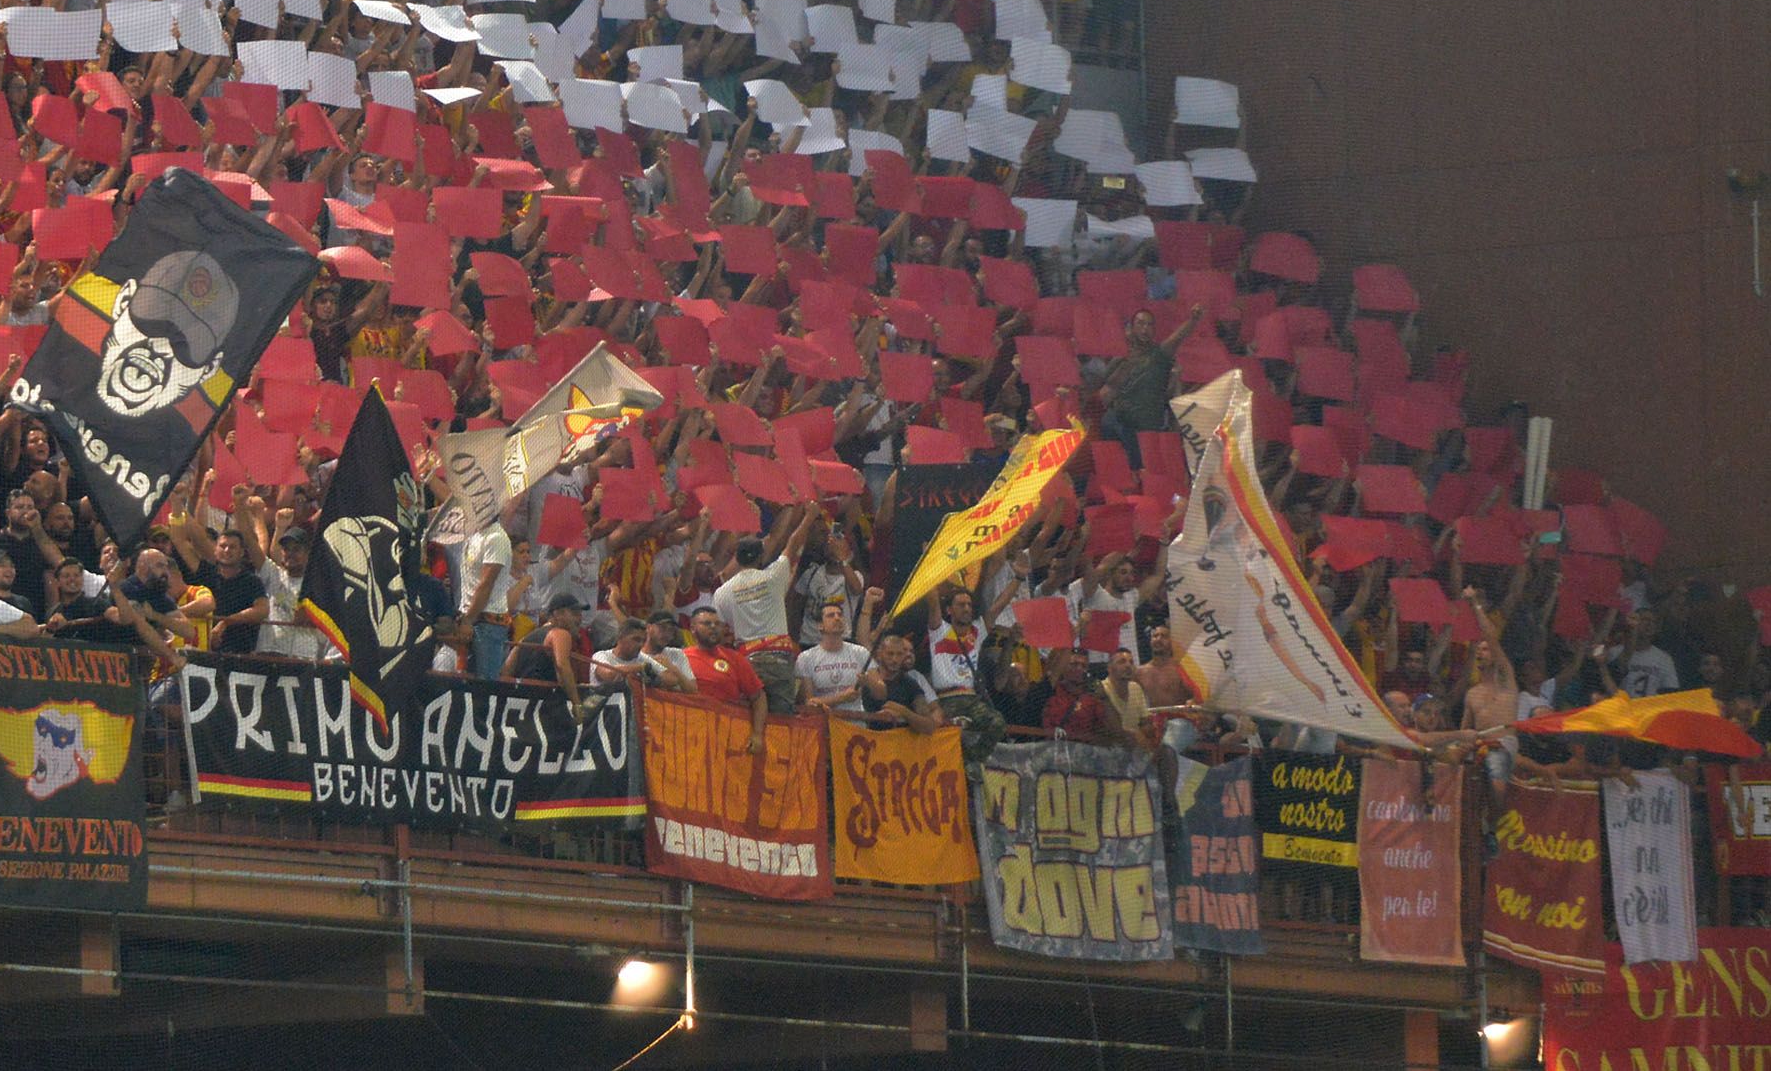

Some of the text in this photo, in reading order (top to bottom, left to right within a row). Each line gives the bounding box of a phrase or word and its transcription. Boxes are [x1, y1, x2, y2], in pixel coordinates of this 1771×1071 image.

[47, 648, 132, 688] MATTE
[421, 690, 628, 775] ANELLO
[313, 762, 514, 819] BENEVENTO
[1290, 755, 1355, 795] modo
[1279, 797, 1346, 833] nostro
[1536, 896, 1587, 930] noi
